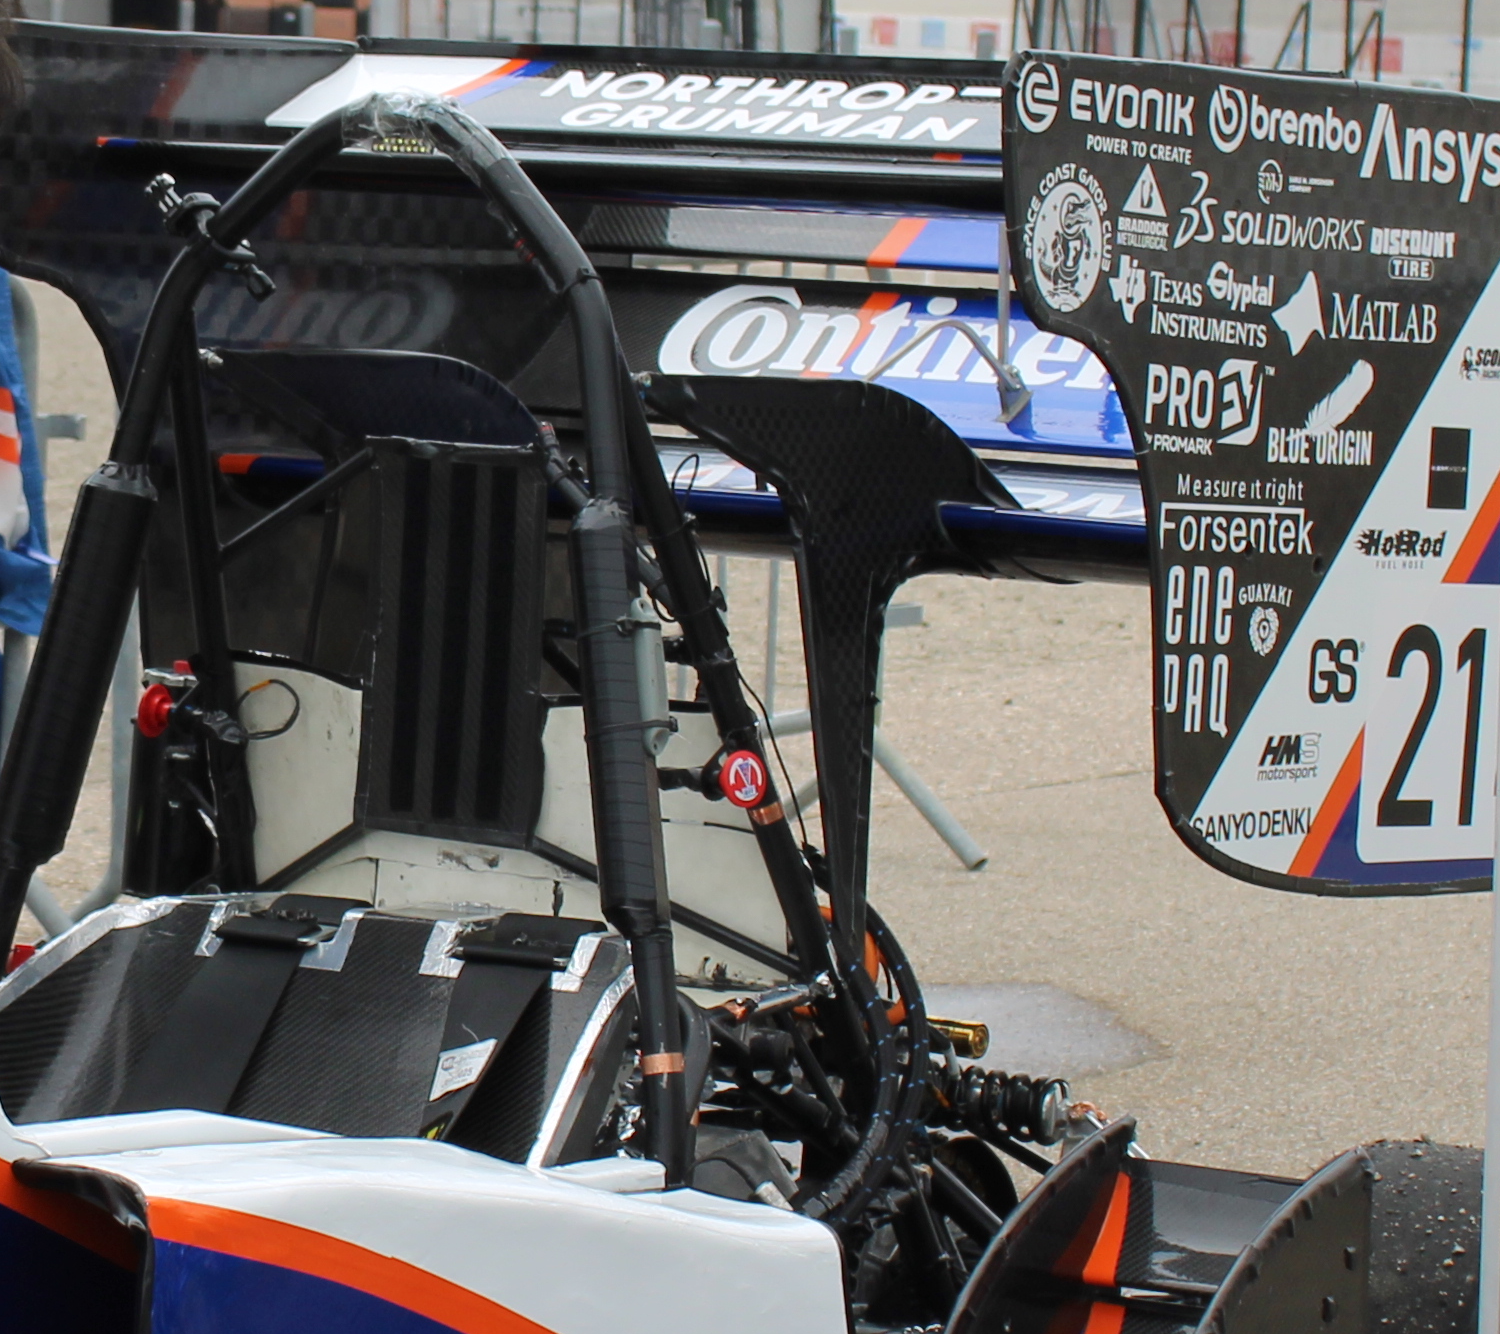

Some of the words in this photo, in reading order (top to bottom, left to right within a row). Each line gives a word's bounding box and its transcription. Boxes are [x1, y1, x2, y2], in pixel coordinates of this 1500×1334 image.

[541, 69, 952, 113] NORTHROP
[1070, 78, 1195, 136] EVONIK
[560, 103, 978, 142] GRUMMAN
[1251, 94, 1362, 154] brembo
[1086, 134, 1128, 156] POWER
[1131, 141, 1146, 158] TO
[1150, 143, 1192, 165] CREATE
[1039, 163, 1076, 195] COAST
[1118, 217, 1169, 237] BRADDOCK
[1221, 210, 1366, 253] SOLIDWORKS
[1370, 227, 1456, 258] DISCOUNT
[1392, 260, 1430, 278] TIRE
[1329, 292, 1437, 344] MATLAB
[1144, 362, 1214, 430] PRO
[1154, 433, 1213, 457] PROMARK
[1267, 426, 1310, 465] BLUE
[1315, 430, 1373, 467] ORIGIN
[1178, 473, 1247, 500] Measure
[1266, 478, 1303, 505] right
[1160, 503, 1313, 555] Forsentek
[1238, 583, 1292, 607] GUAYAKI
[1309, 639, 1359, 704] GS
[1376, 624, 1492, 827] 21
[1258, 733, 1321, 767] HMS
[1257, 763, 1318, 783] motorsport
[1192, 810, 1256, 844] SANYO
[1259, 807, 1312, 837] DENKI
